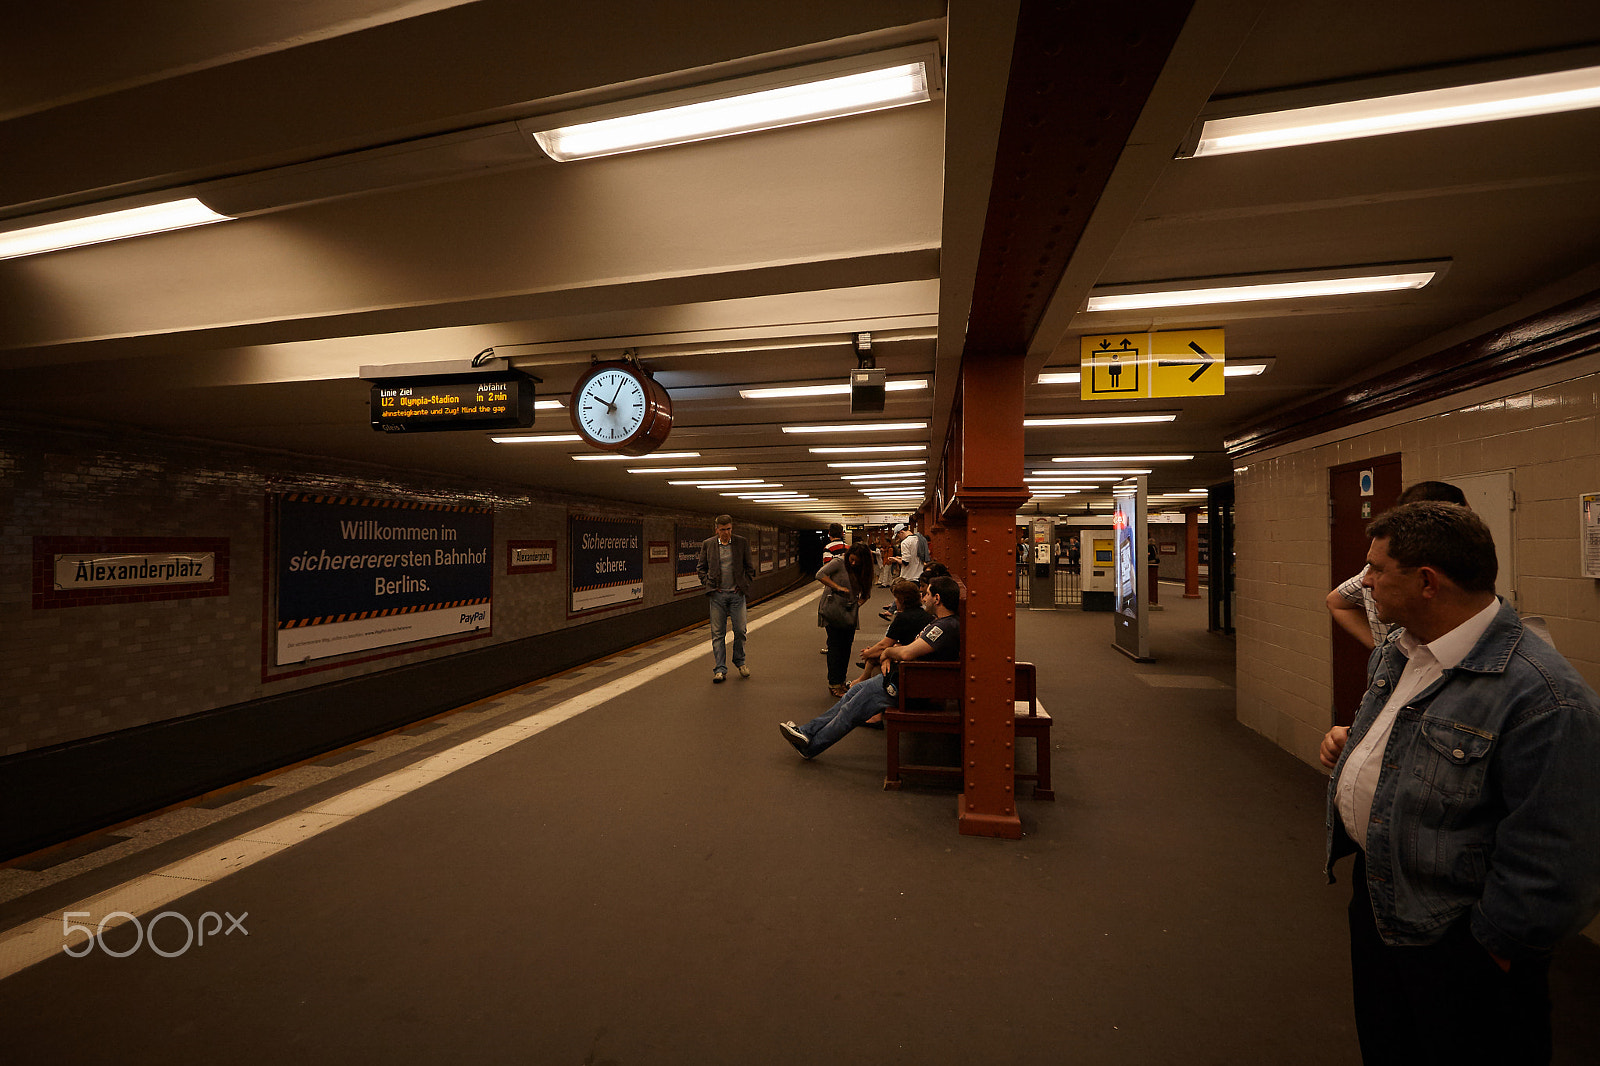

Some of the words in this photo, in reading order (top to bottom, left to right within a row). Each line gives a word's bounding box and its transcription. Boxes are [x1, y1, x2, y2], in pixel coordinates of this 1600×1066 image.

[380, 389, 397, 397] Linie
[399, 388, 413, 396] Ziel
[478, 382, 507, 392] Abfahrt
[381, 397, 395, 407] U2
[400, 395, 460, 407] Olympia-Stadion
[476, 393, 484, 402] in
[488, 392, 494, 402] 2
[494, 391, 507, 401] min
[430, 407, 443, 415] und
[444, 406, 460, 415] Zug!
[478, 405, 491, 413] the
[492, 406, 506, 414] gap
[340, 520, 438, 541] Willkommen
[441, 524, 457, 541] im
[581, 532, 629, 550] Sicherererer
[629, 534, 639, 549] ist
[288, 548, 432, 572] sicherererersten
[434, 547, 487, 566] Bahnhof
[595, 556, 627, 574] sicherer.
[75, 558, 203, 582] Alexanderplatz
[375, 575, 431, 596] Berlins.
[460, 611, 486, 624] PayPal
